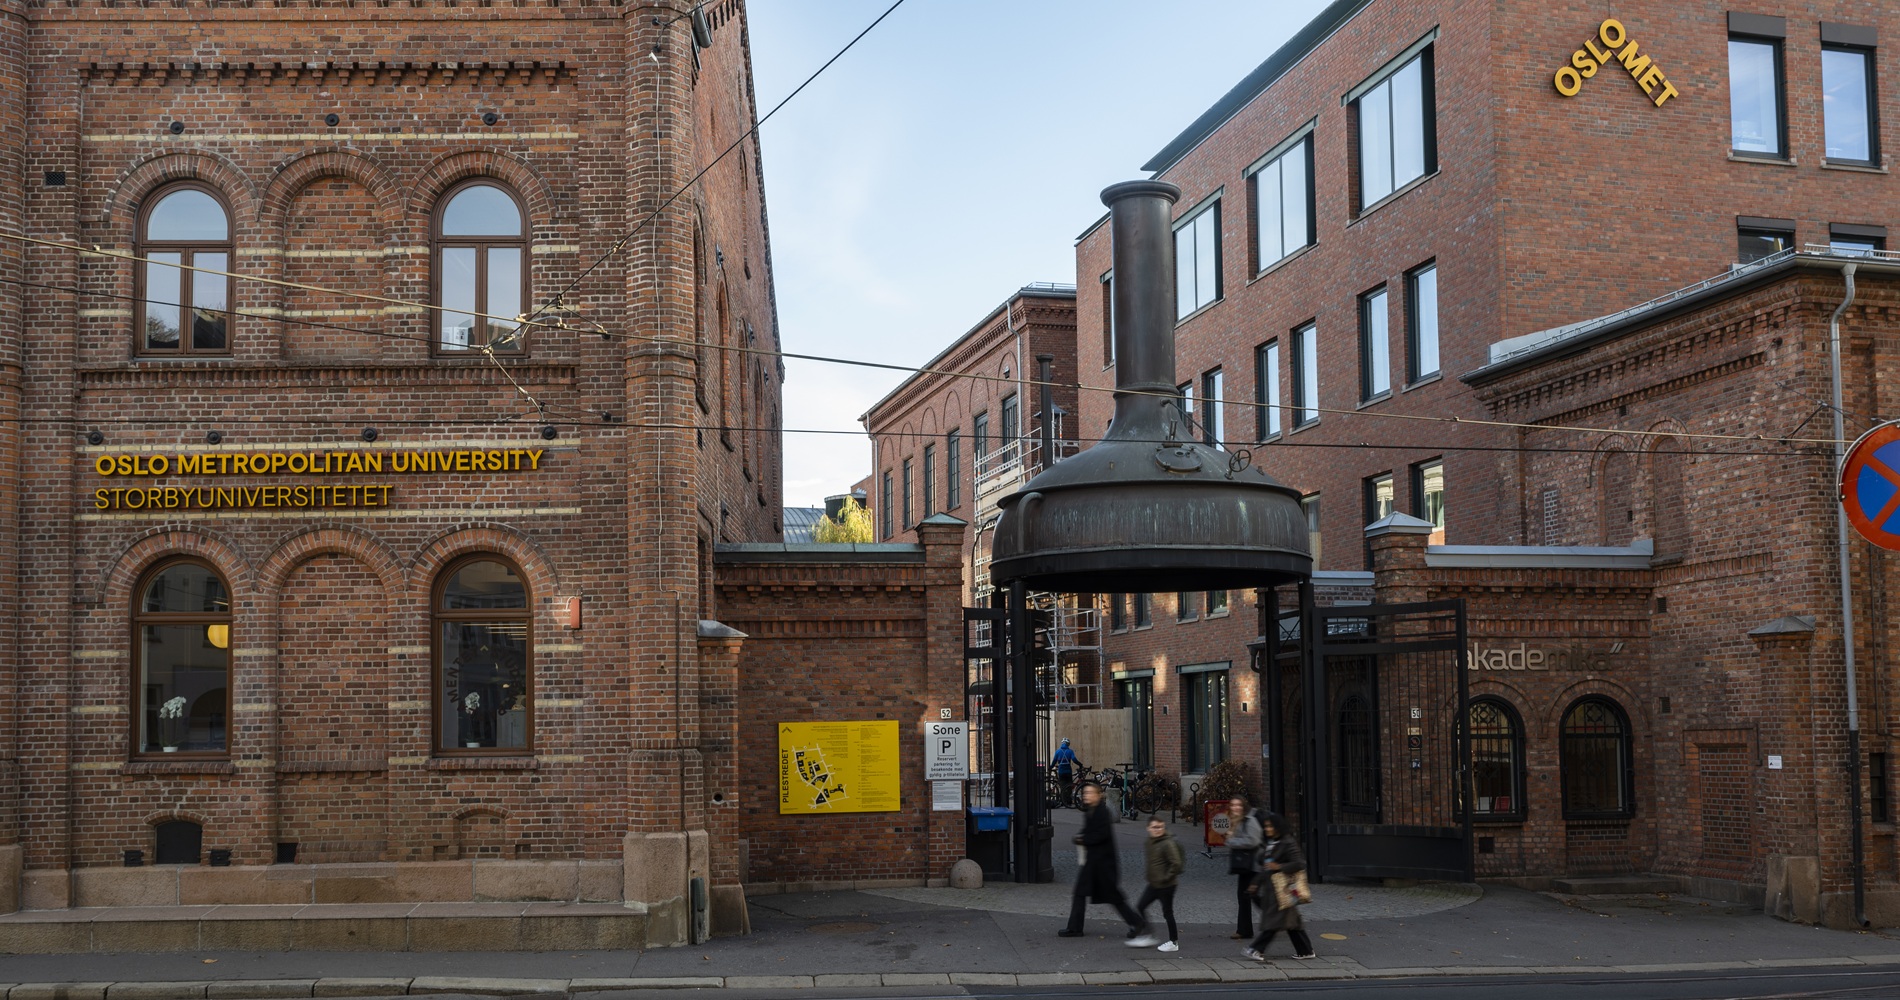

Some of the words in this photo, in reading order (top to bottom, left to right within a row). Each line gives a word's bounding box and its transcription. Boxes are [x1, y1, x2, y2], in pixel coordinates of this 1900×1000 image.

[94, 453, 170, 476] OSLO
[177, 451, 383, 475] METROPOLITAN
[391, 449, 544, 473] UNIVERSITY
[94, 483, 394, 510] STORBYUNIVERSITETET
[942, 709, 951, 718] 52
[932, 724, 961, 735] Sone
[942, 740, 951, 754] P
[781, 748, 790, 803] PILESTREDET
